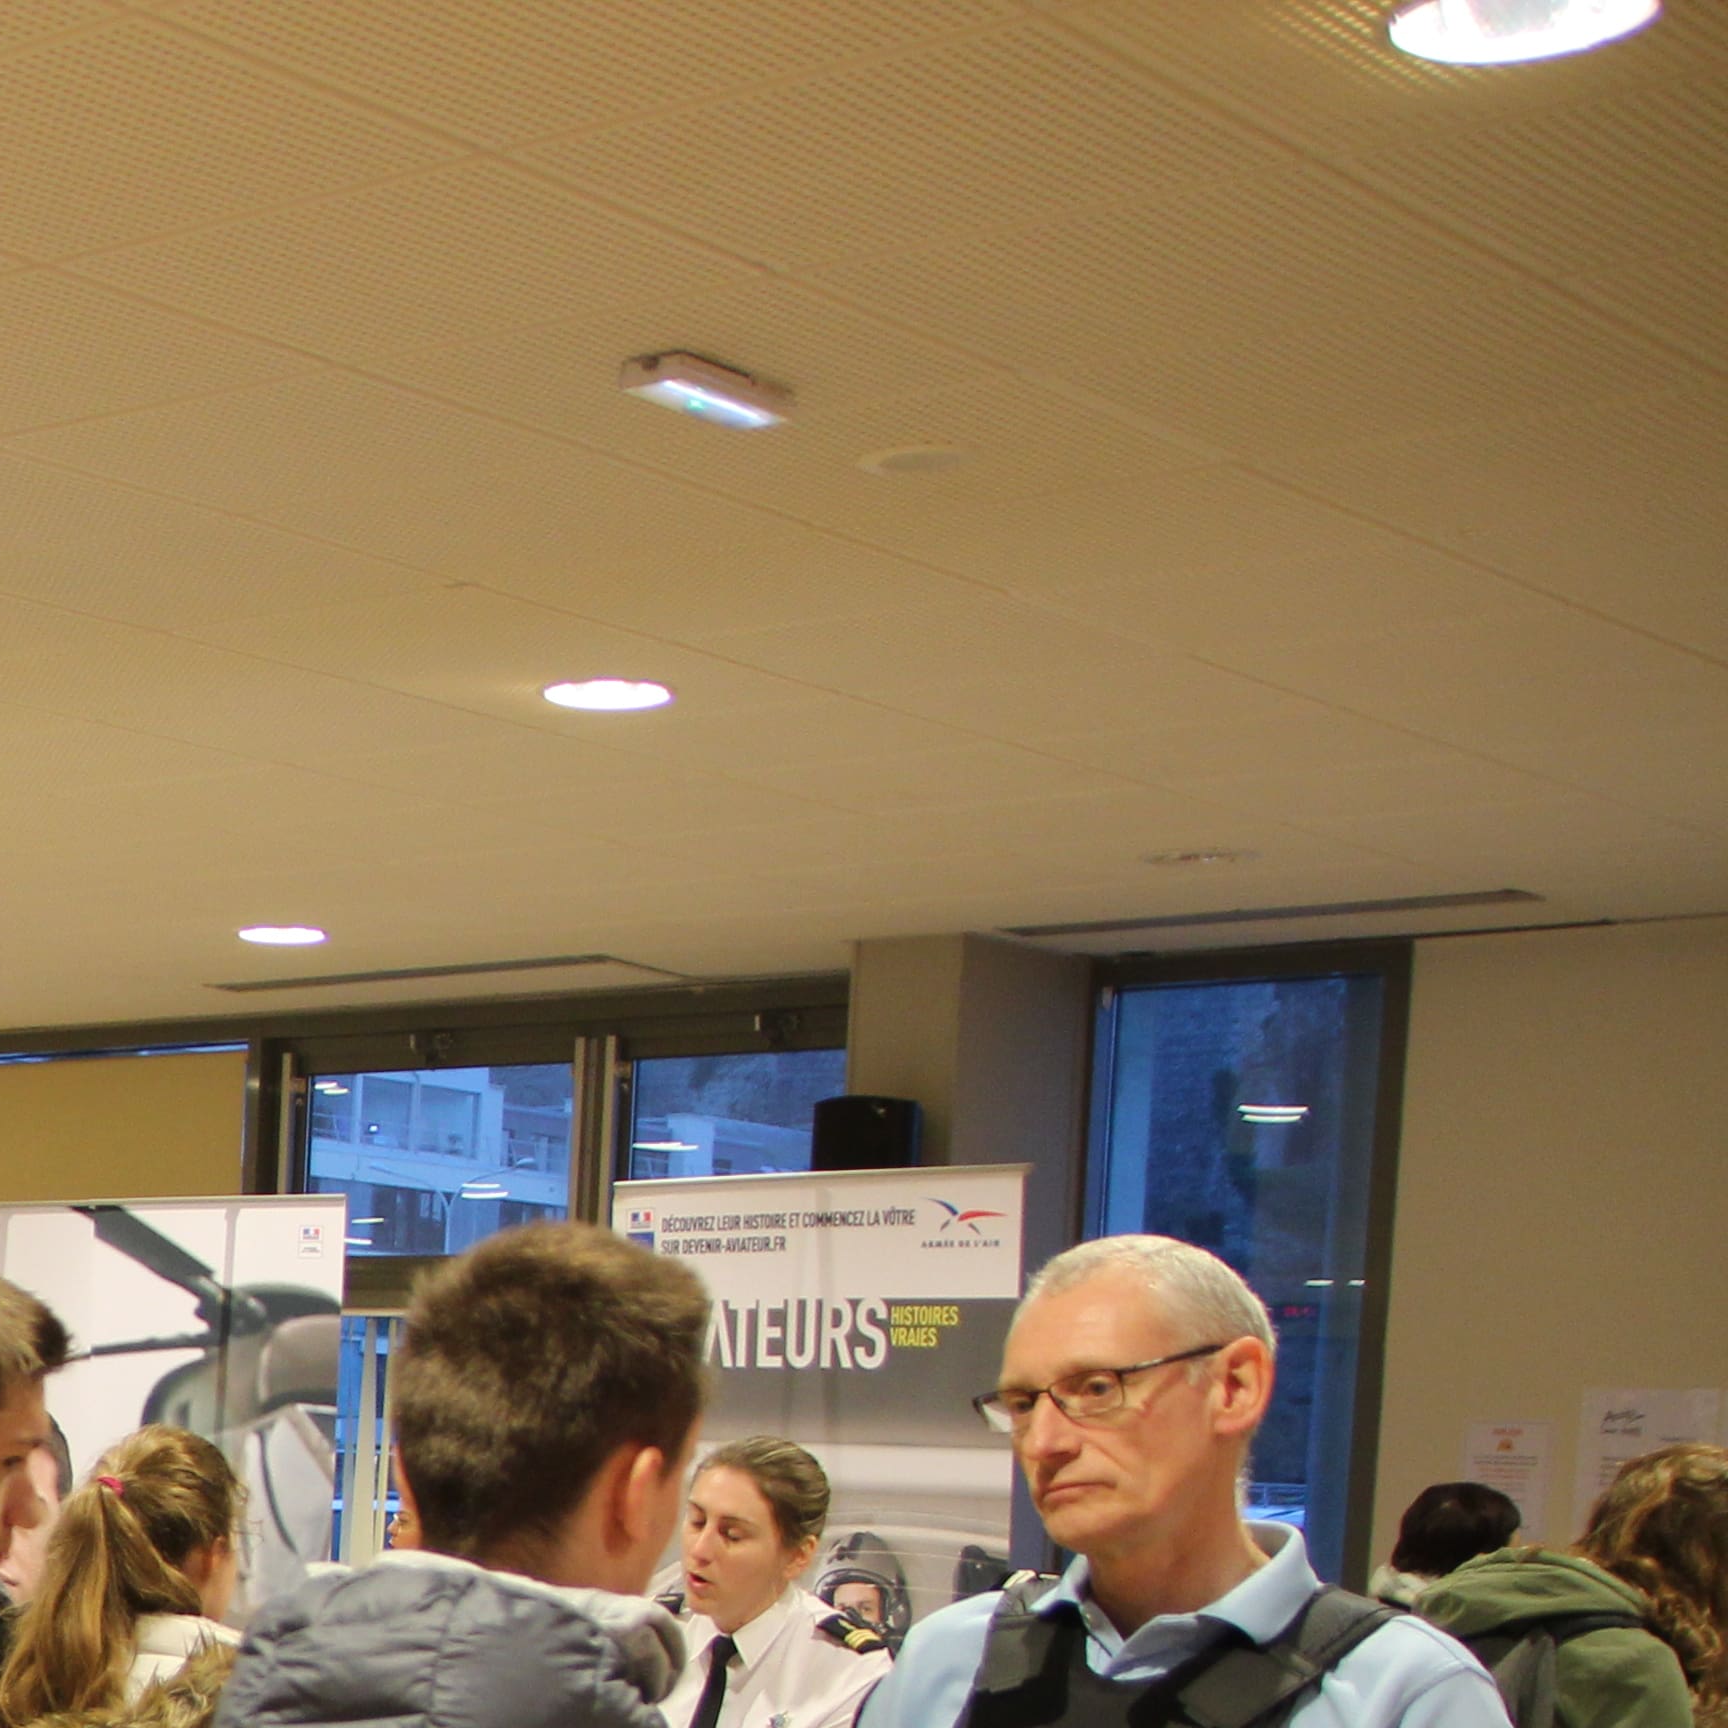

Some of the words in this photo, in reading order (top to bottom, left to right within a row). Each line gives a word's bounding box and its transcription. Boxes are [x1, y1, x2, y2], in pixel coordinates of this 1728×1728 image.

[661, 1212, 715, 1232] DÉCOUVREZ
[717, 1214, 741, 1231] LEUR
[744, 1212, 787, 1230] HISTOIRE
[788, 1212, 801, 1228] ET
[802, 1209, 865, 1229] COMMENCEZ
[867, 1209, 880, 1225] LA
[881, 1206, 916, 1226] VÔTRE
[661, 1238, 681, 1255] SUR
[682, 1235, 786, 1254] DEVENIR-AVIATEUR.FR
[891, 1305, 959, 1325] HISTOIRES
[704, 1298, 889, 1370] ATEURS
[890, 1327, 938, 1347] VRAIES
